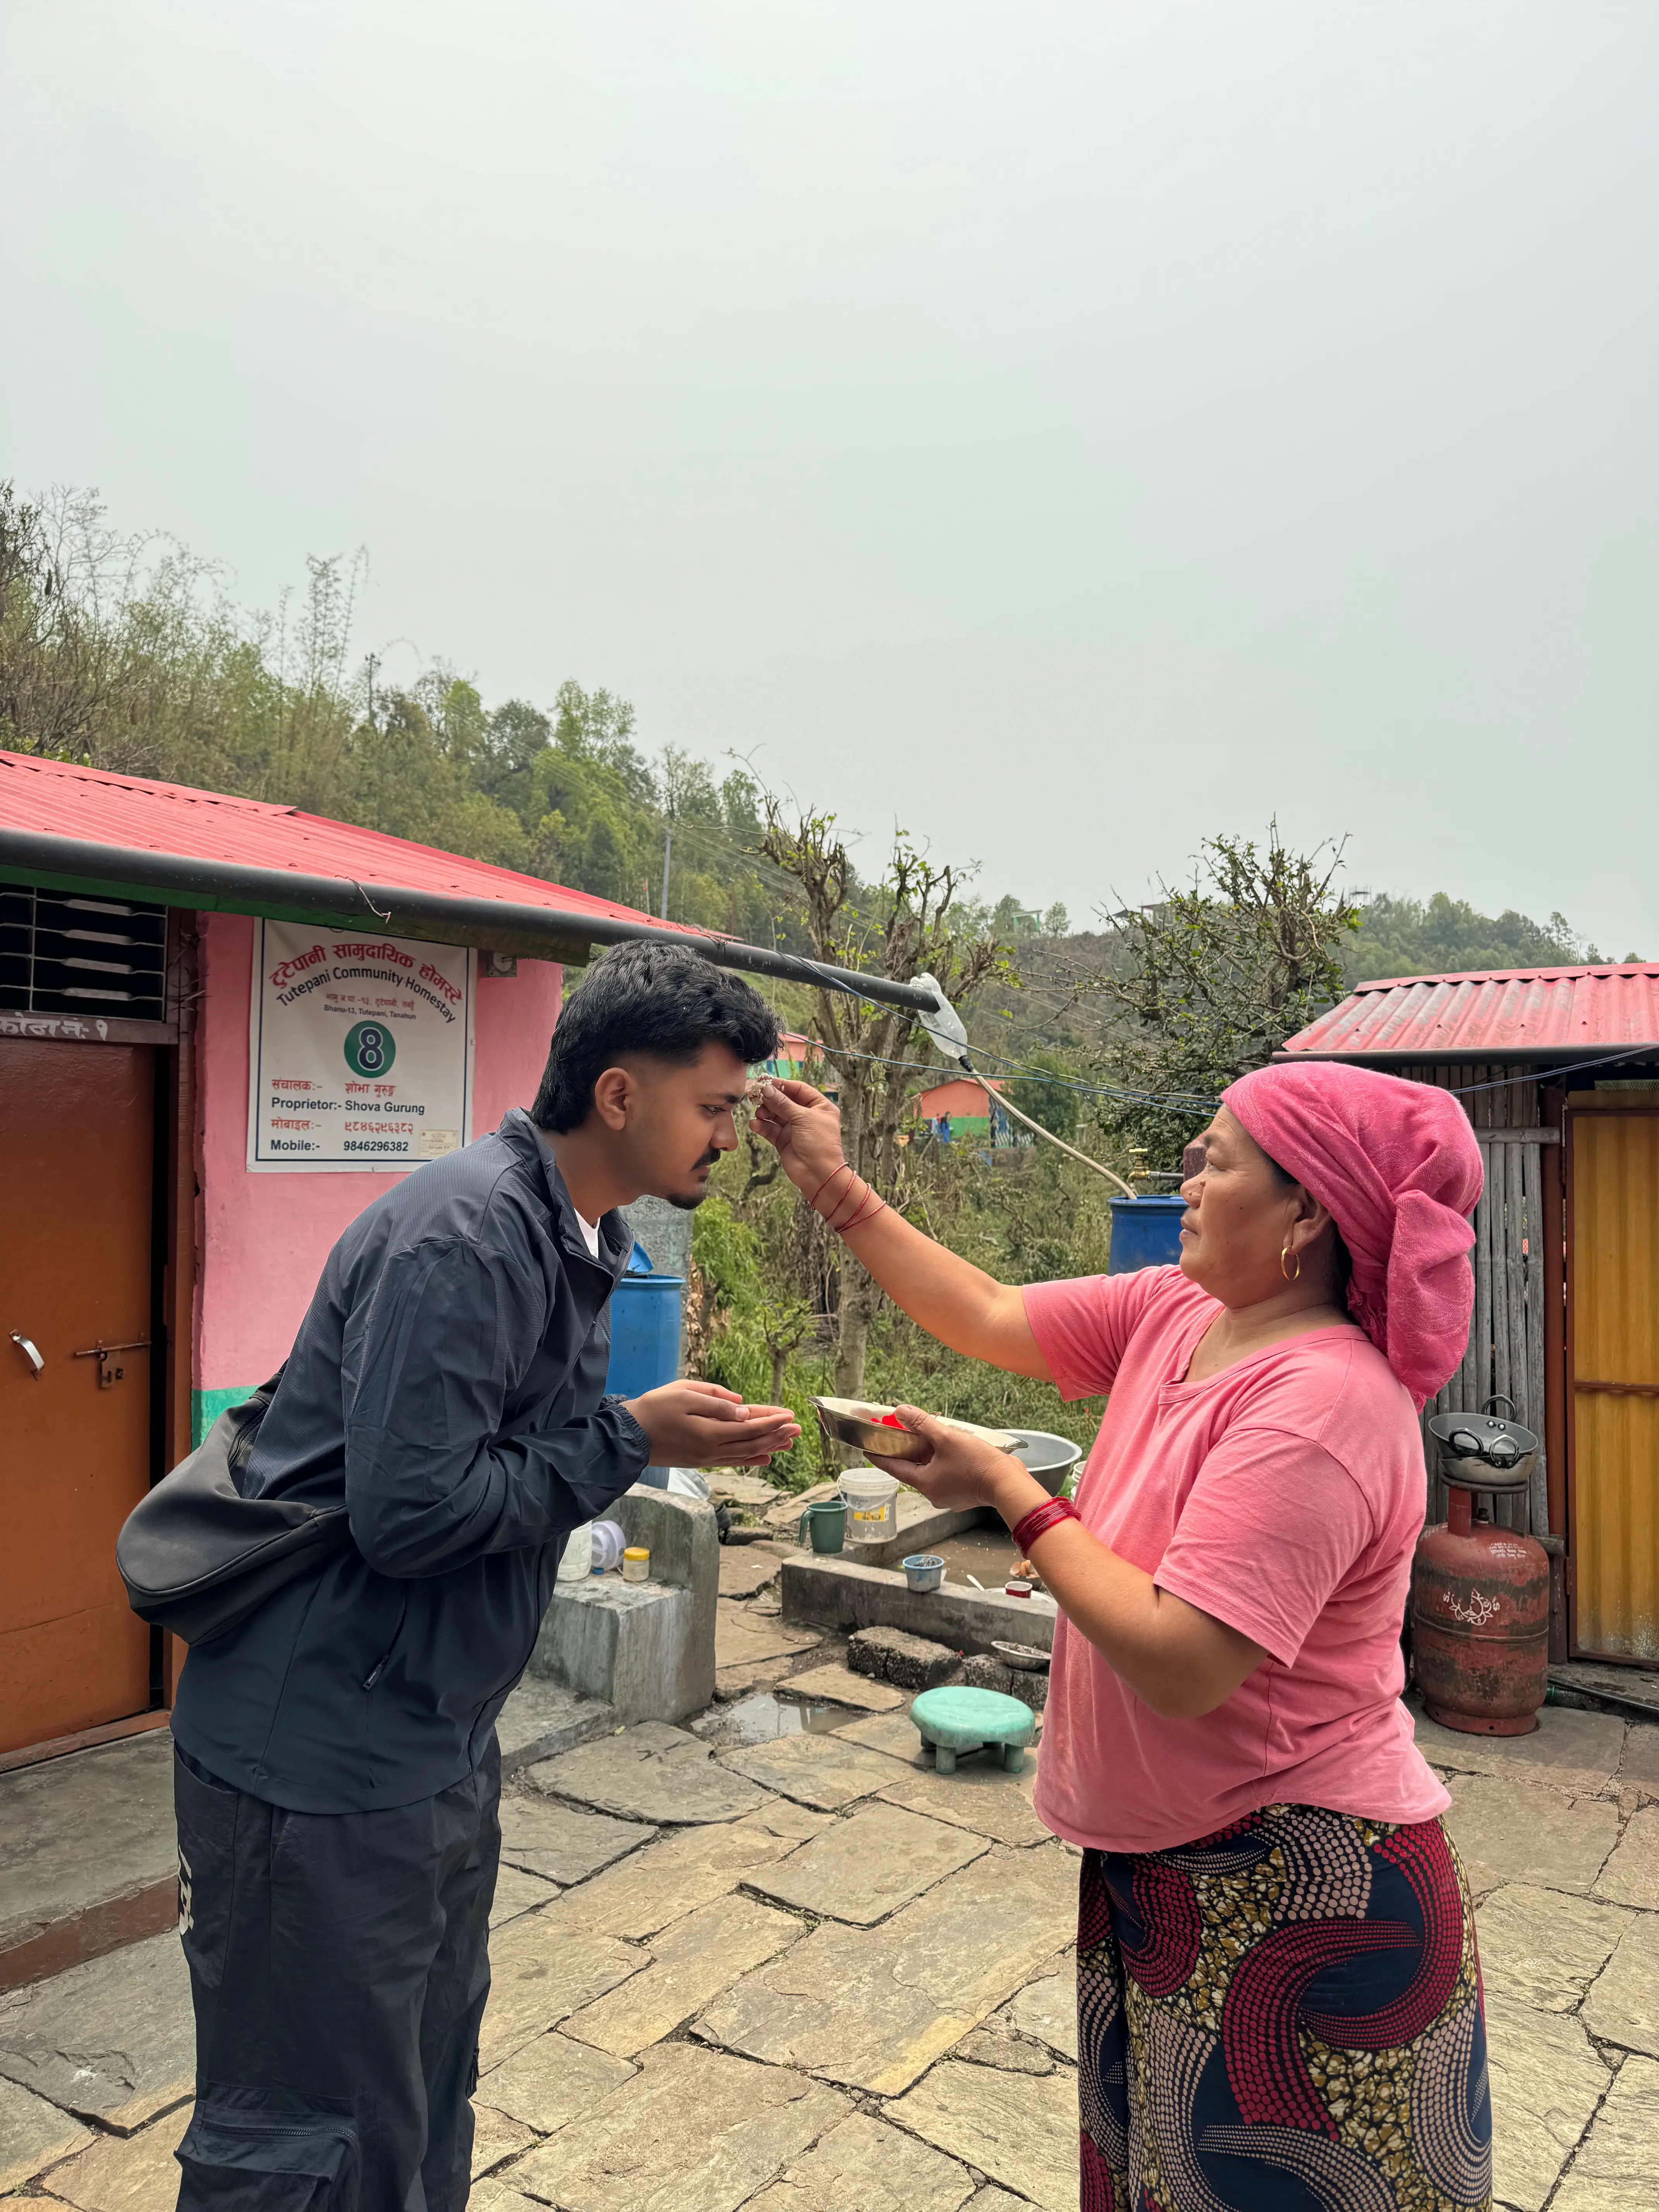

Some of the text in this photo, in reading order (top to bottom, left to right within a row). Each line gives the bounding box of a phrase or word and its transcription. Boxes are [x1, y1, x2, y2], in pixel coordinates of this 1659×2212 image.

[331, 943, 416, 969] सामुदायिक
[419, 963, 462, 1005] होमस्टे
[276, 967, 456, 1024] Tutepani Community Homestay
[324, 1004, 416, 1020] Bhanu-13, Tutepani, Tanahun
[357, 1027, 384, 1071] 8
[345, 1081, 370, 1094] शोभा
[271, 1097, 425, 1115] Proprietor:- Shova Gurung
[345, 1121, 414, 1135] ९८४६२९६३८२
[271, 1140, 409, 1152] Mobile:- 9846296382
